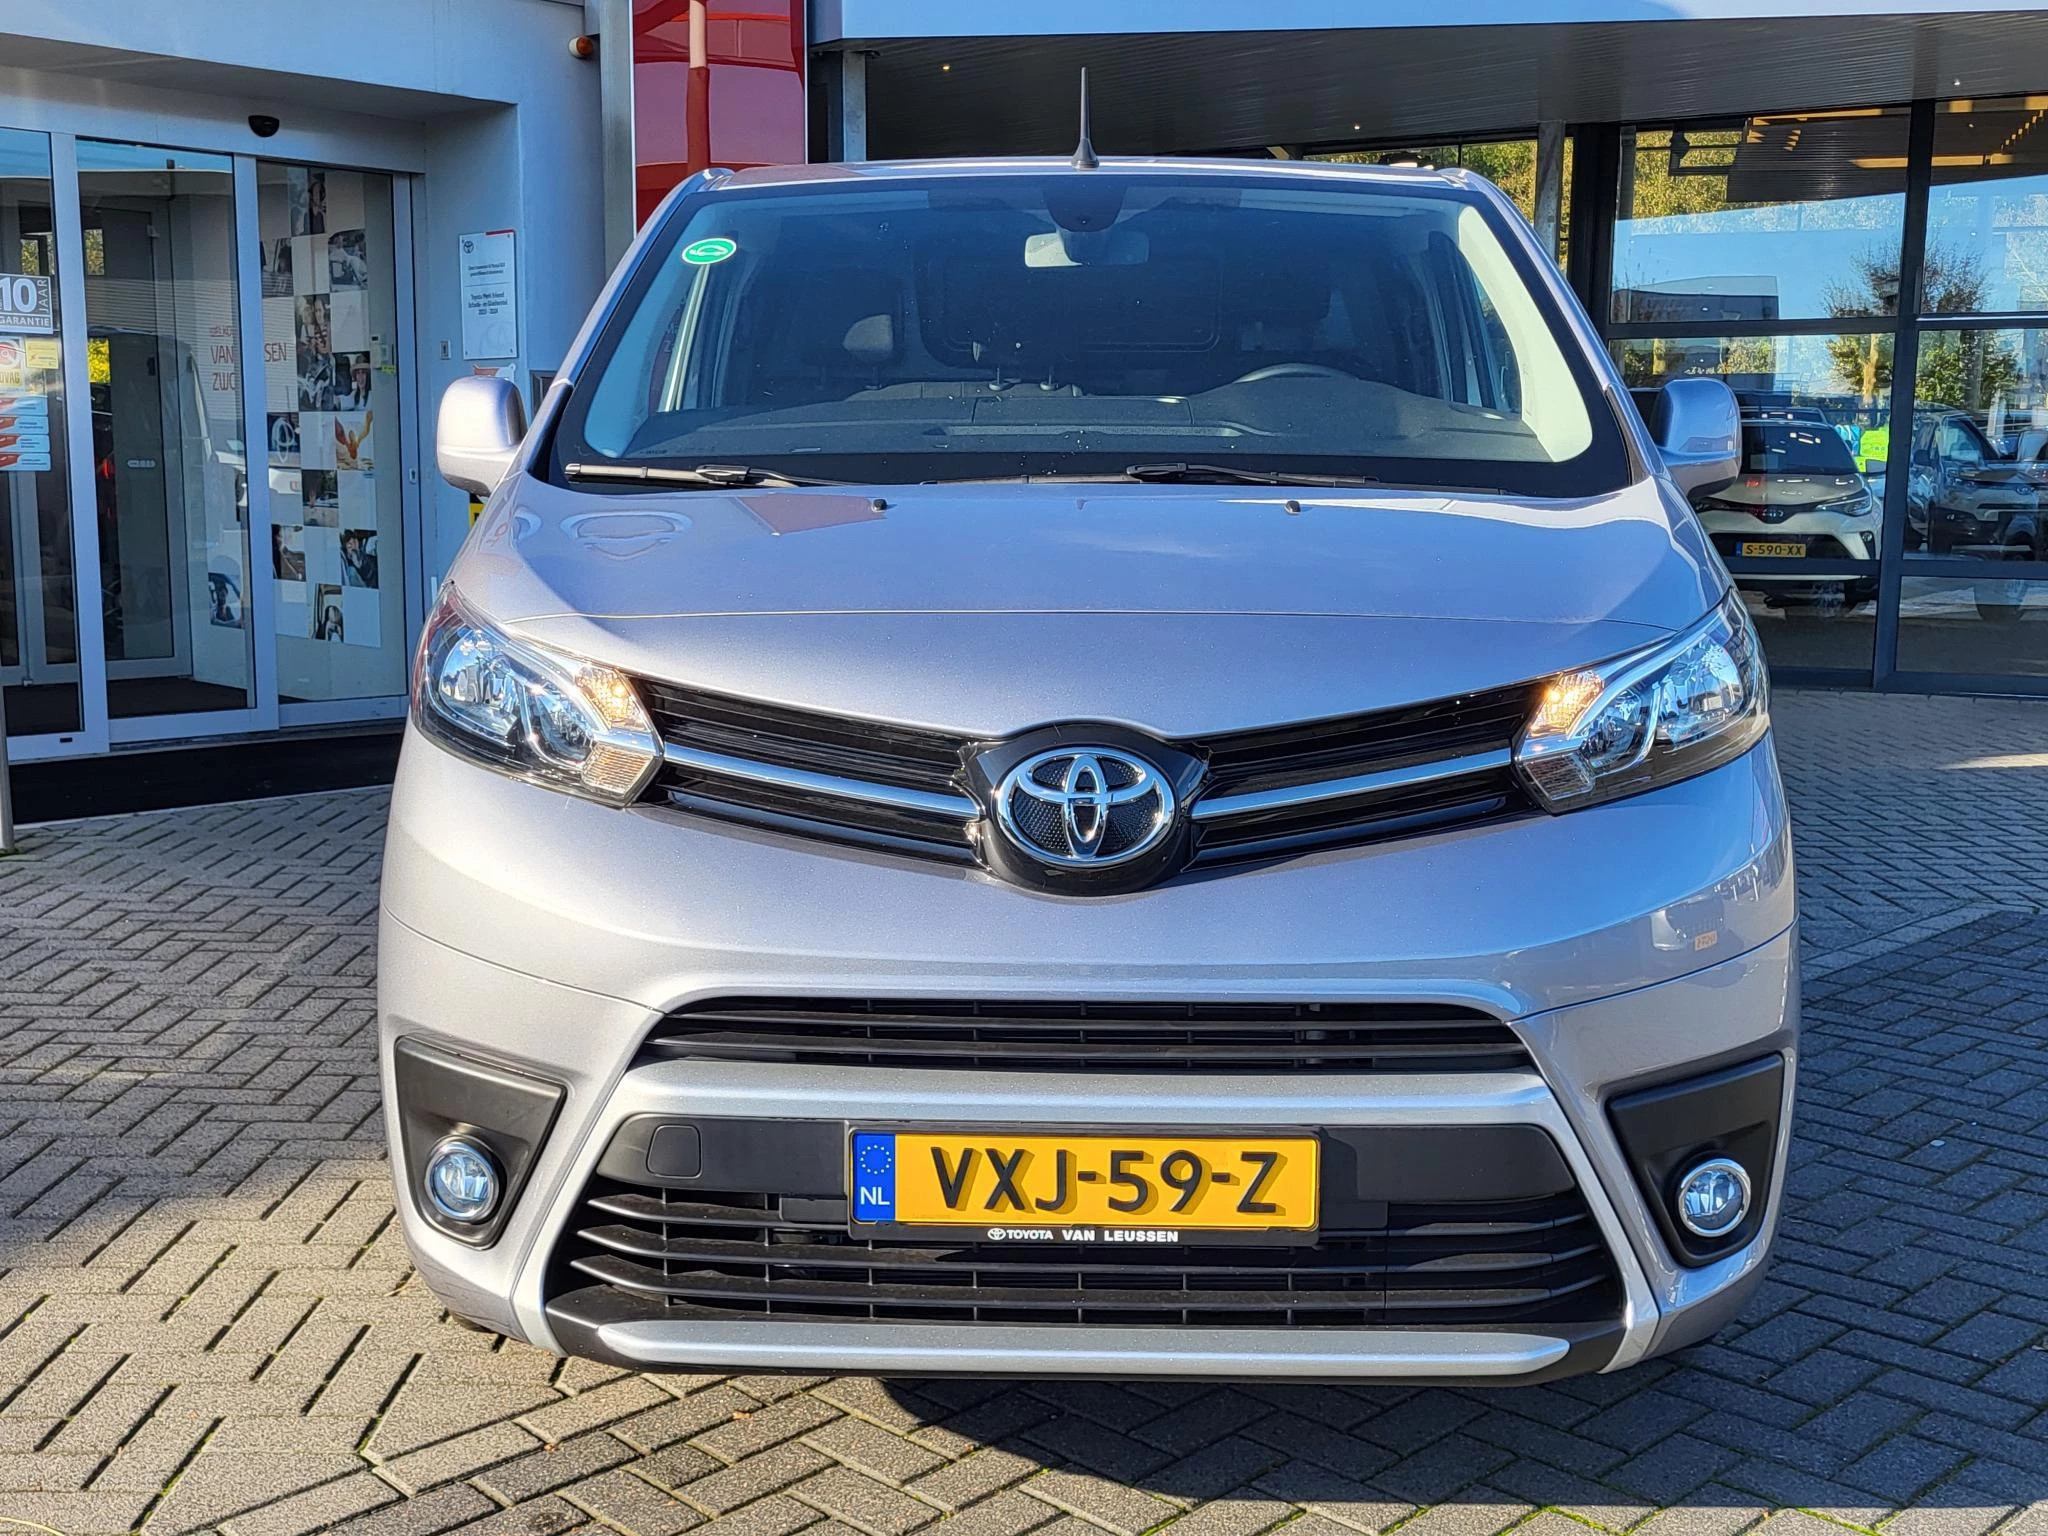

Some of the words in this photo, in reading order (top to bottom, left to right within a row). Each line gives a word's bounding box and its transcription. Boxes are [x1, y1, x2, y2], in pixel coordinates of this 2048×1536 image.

[0, 277, 37, 313] 10
[37, 279, 49, 314] JAAR
[0, 315, 50, 327] GARANTIE
[1745, 544, 1802, 556] S-590-XX
[930, 1146, 1279, 1213] VXJ-59-Z
[860, 1185, 890, 1206] NL
[1006, 1229, 1054, 1241] TOYOTA
[1062, 1229, 1096, 1242] VAN
[1104, 1230, 1179, 1243] LEUSSEN
